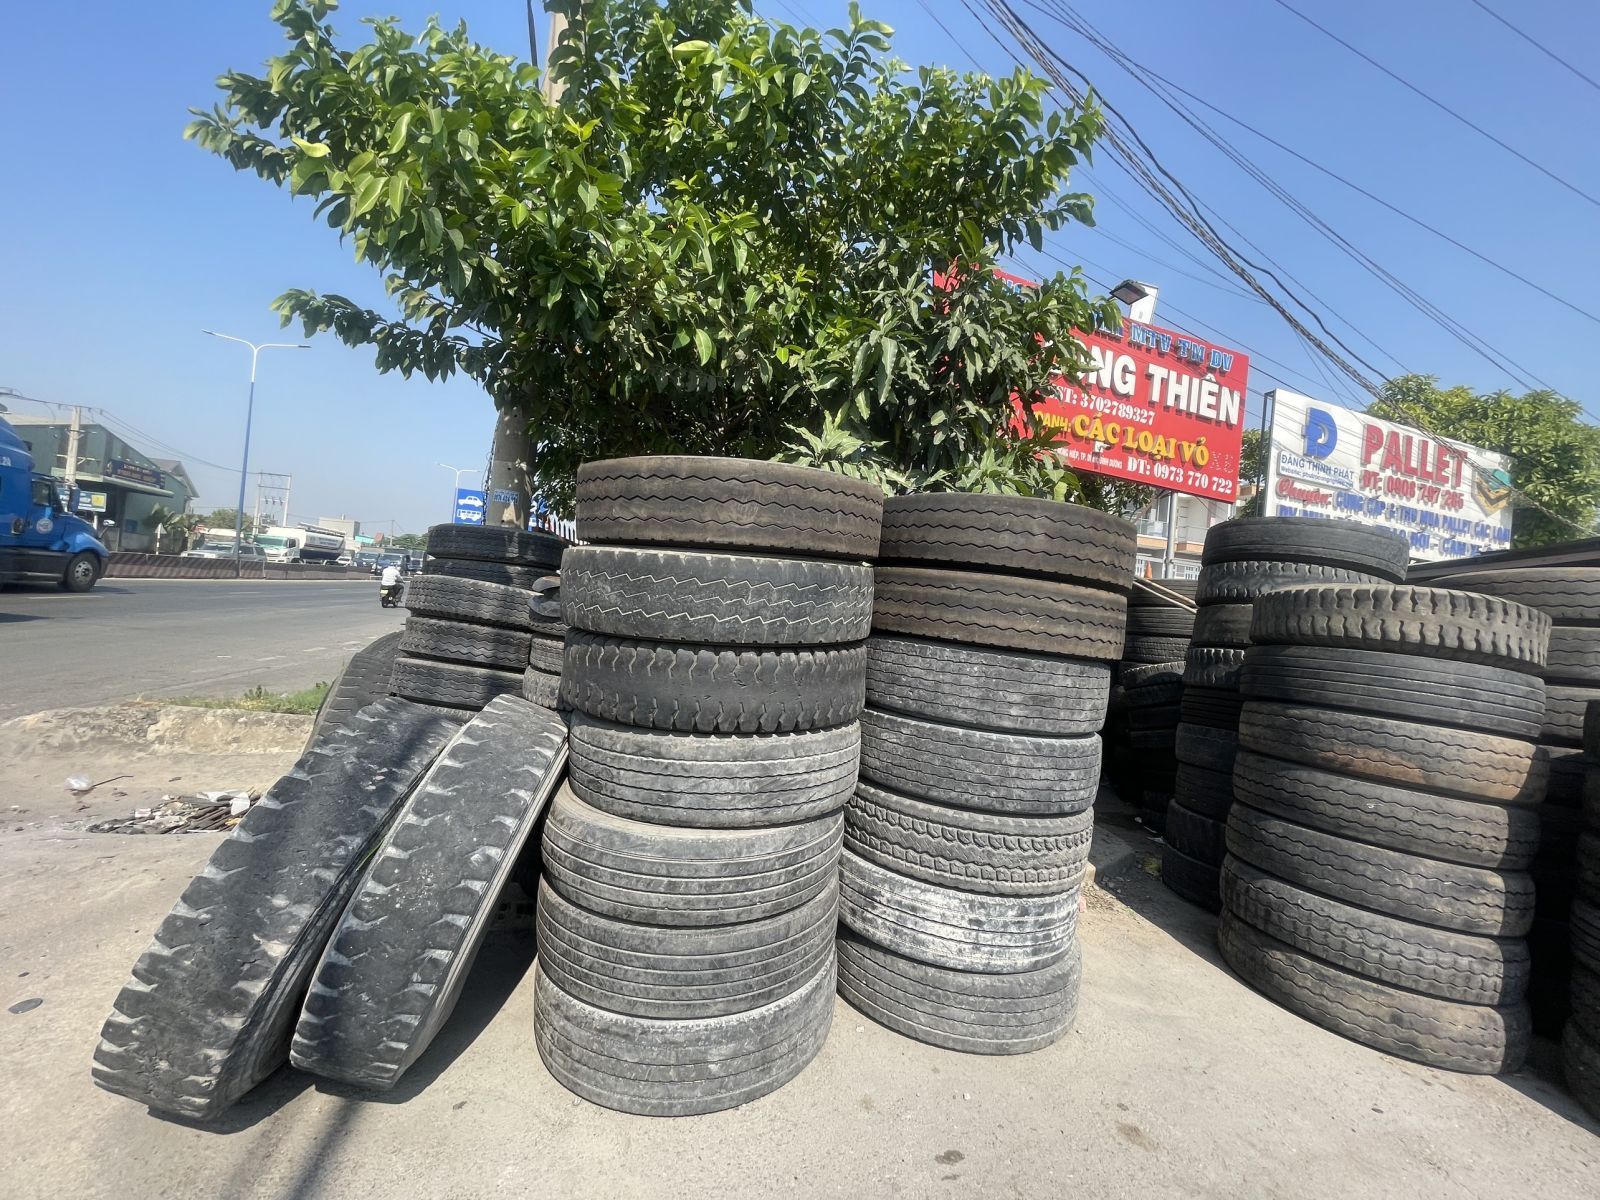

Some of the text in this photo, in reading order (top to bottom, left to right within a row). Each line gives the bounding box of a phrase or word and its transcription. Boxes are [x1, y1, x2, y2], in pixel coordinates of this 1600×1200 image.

[1131, 322, 1173, 353] MTV
[1177, 338, 1206, 363] TM
[1210, 348, 1234, 373] DV
[1050, 384, 1156, 426] ST: 3702789327
[1149, 363, 1240, 426] THIÊN
[1074, 412, 1121, 445] CÁC
[1121, 425, 1178, 460] LOẠI
[1181, 436, 1210, 467] VỎ
[1362, 422, 1468, 488] PALLET
[1153, 462, 1184, 484] 0973
[1187, 470, 1209, 489] 770
[1211, 476, 1233, 495] 722
